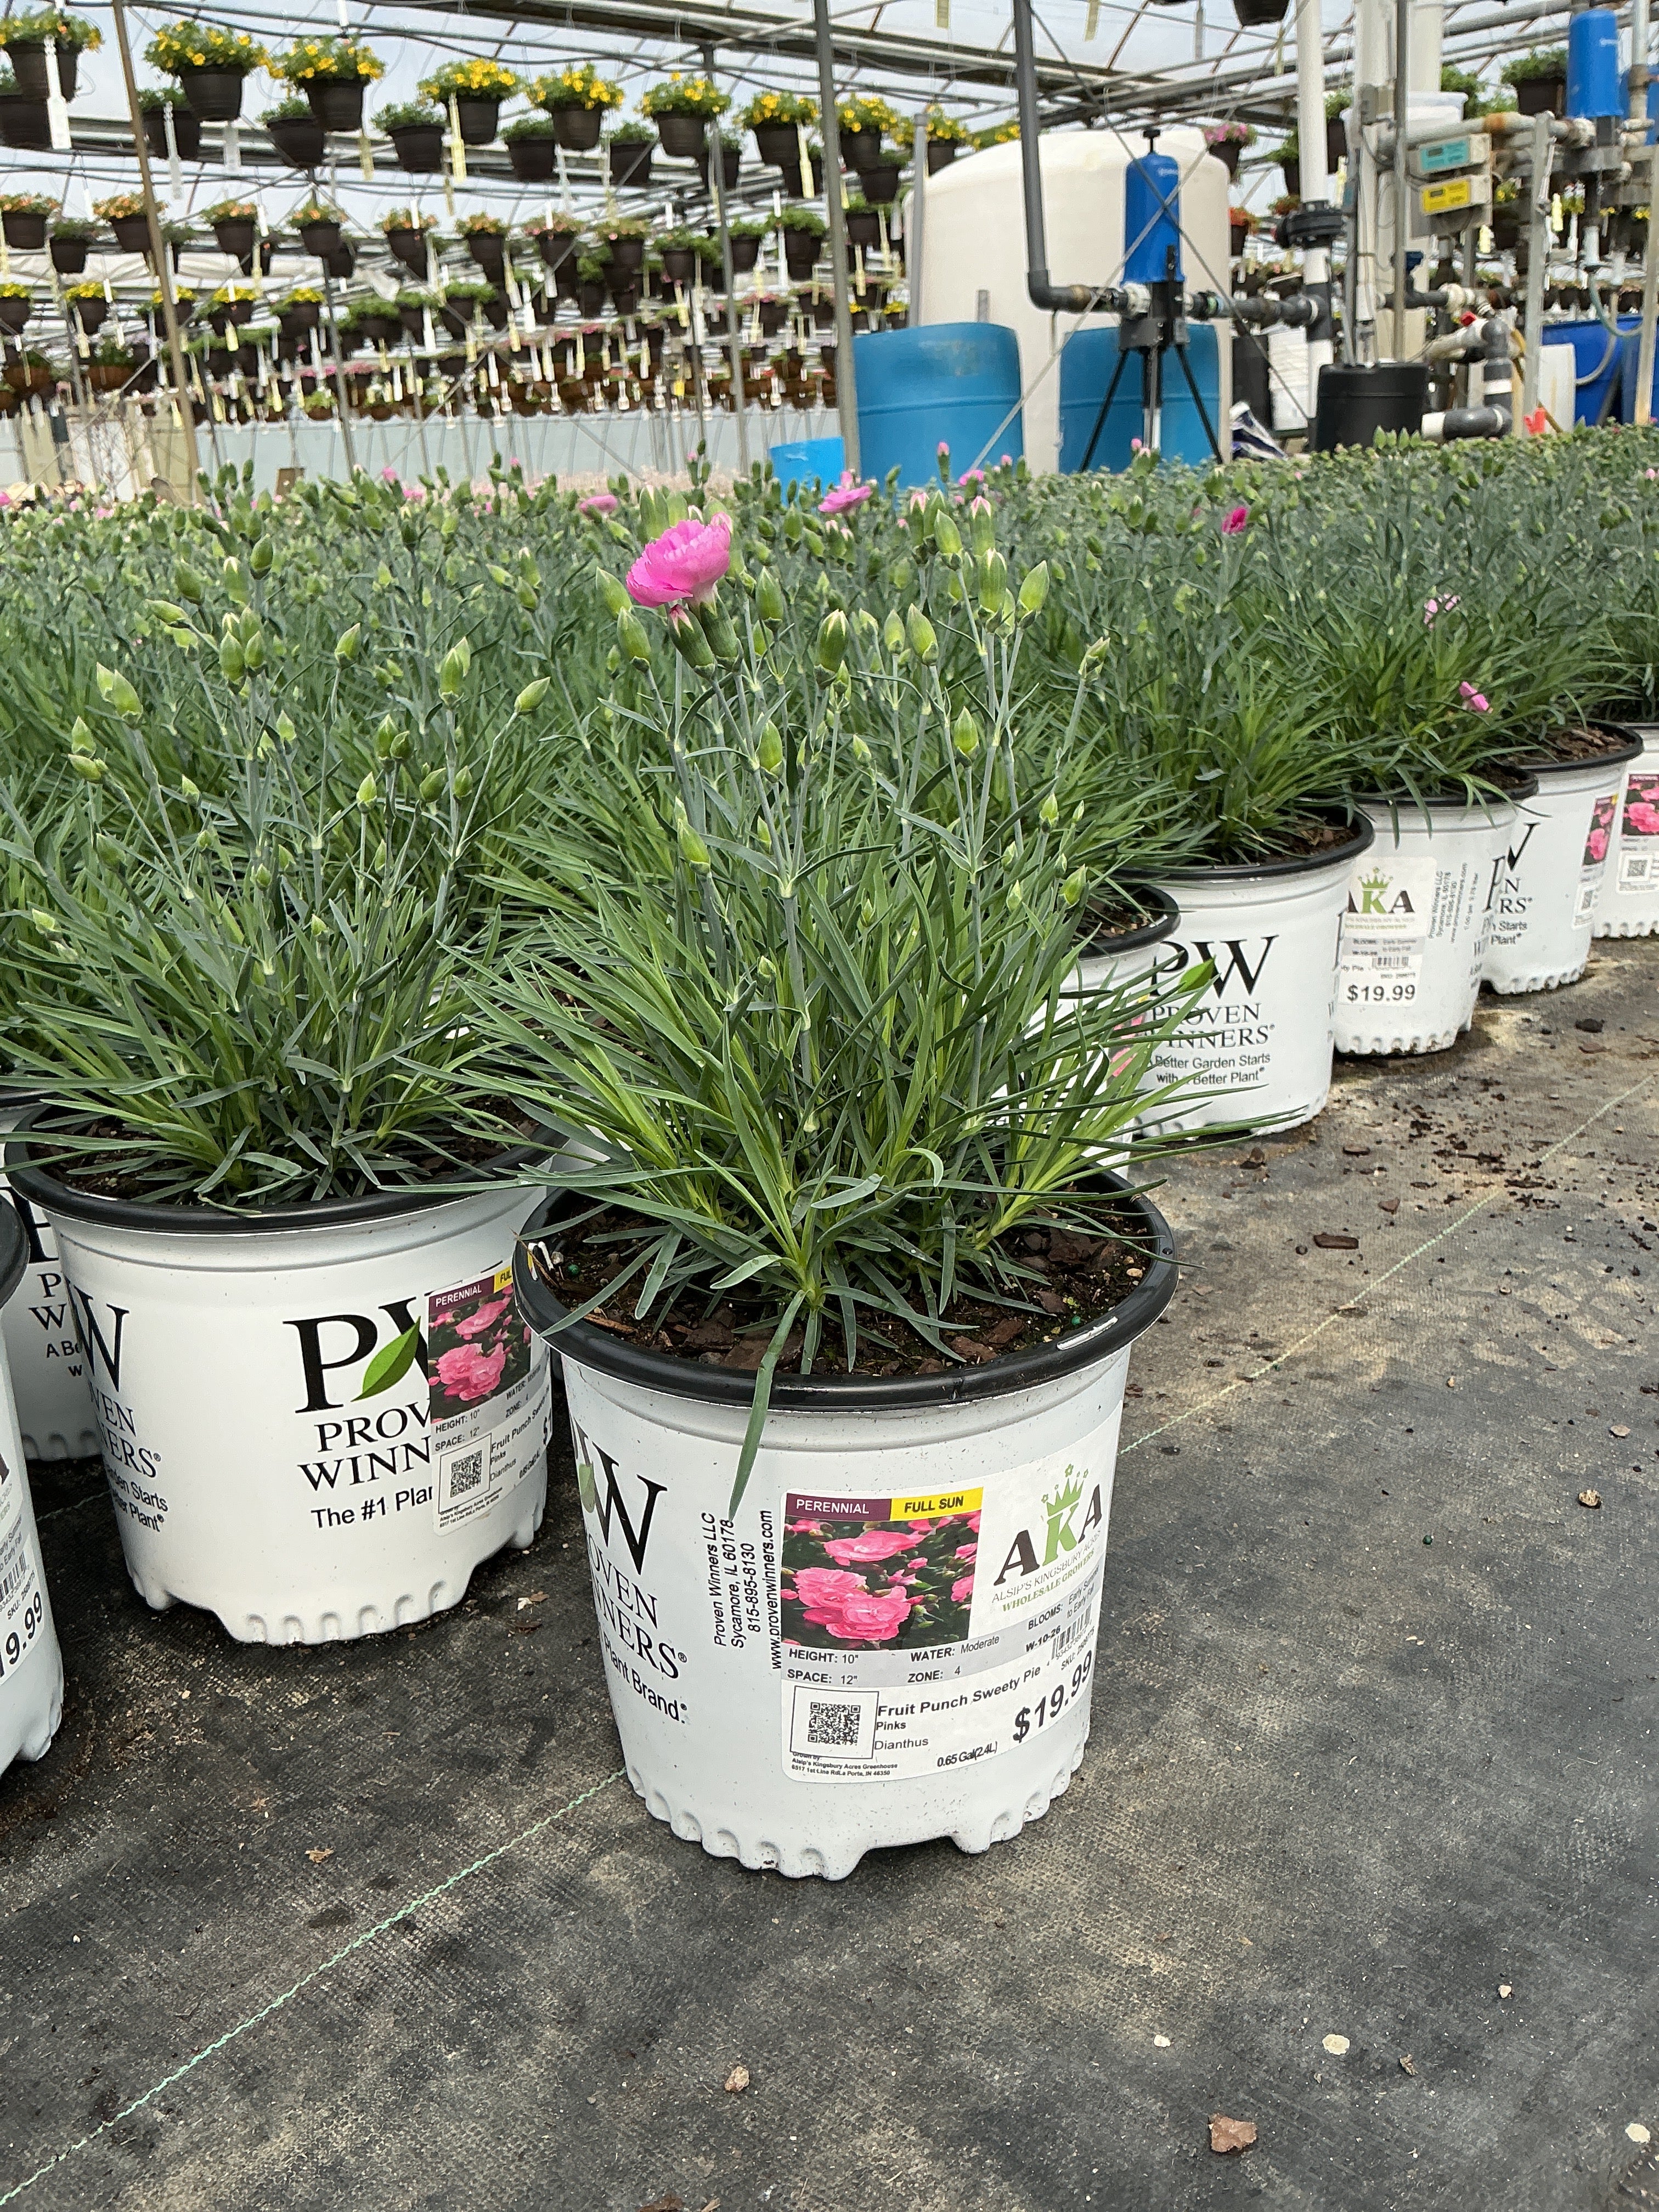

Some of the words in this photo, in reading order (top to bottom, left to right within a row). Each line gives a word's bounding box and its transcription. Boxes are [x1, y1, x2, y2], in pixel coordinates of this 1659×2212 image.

[1346, 984, 1416, 1003] $19.99
[1147, 1024, 1276, 1049] INNERS
[1193, 1057, 1235, 1069] Garden
[1239, 1053, 1271, 1066] Starts
[1156, 1073, 1178, 1084] with
[1193, 1074, 1228, 1085] Better
[435, 1284, 485, 1308] PERENNIAL
[435, 1415, 468, 1434] HEIGHT:
[470, 1409, 481, 1420] 10"
[435, 1434, 465, 1452] SPACE:
[470, 1426, 480, 1438] 12"
[491, 1433, 510, 1453] Fruit
[490, 1458, 517, 1482] Dianthus
[132, 1480, 169, 1513] Starts
[796, 1498, 870, 1515] PERENNIAL
[904, 1499, 935, 1514] FULL
[938, 1495, 964, 1509] SUN
[311, 1506, 356, 1528] The
[360, 1496, 387, 1521] #1
[701, 1512, 717, 1541] LLC
[993, 1483, 1103, 1587] AKA
[720, 1519, 737, 1561] 60178
[708, 1543, 723, 1597] Winners
[724, 1564, 738, 1577] IL
[991, 1579, 1032, 1604] ALSIP'S
[1034, 1549, 1084, 1585] KINGSBURY
[1002, 1577, 1061, 1612] WHOLESALE
[1062, 1549, 1095, 1583] GROWERS
[740, 1543, 761, 1633] 815-895-8130
[759, 1510, 782, 1670] www.provenwinners.com
[729, 1581, 747, 1649] Sycamore,
[1028, 1603, 1064, 1630] BLOOMS:
[1068, 1587, 1083, 1605] Early
[1066, 1608, 1073, 1619] to
[1073, 1594, 1087, 1613] Early
[714, 1601, 727, 1647] Proven
[910, 1646, 956, 1662] WATER:
[961, 1635, 1000, 1654] Moderate
[1025, 1624, 1062, 1653] W-10-26
[603, 1631, 631, 1684] Plant
[788, 1647, 838, 1663] HEIGHT:
[842, 1654, 859, 1664] 10"
[787, 1668, 832, 1684] SPACE:
[840, 1675, 858, 1685] 12"
[907, 1670, 944, 1683] ZONE:
[954, 1666, 961, 1675] 4
[878, 1705, 916, 1717] Fruit
[920, 1694, 968, 1713] Punch
[973, 1677, 1020, 1702] Sweety
[1023, 1666, 1041, 1683] Pie
[1013, 1649, 1093, 1743] $19.99
[876, 1721, 906, 1731] Pinks
[874, 1737, 929, 1750] Dianthus
[812, 1761, 843, 1769] Kingsbury
[936, 1752, 958, 1767] 0.65
